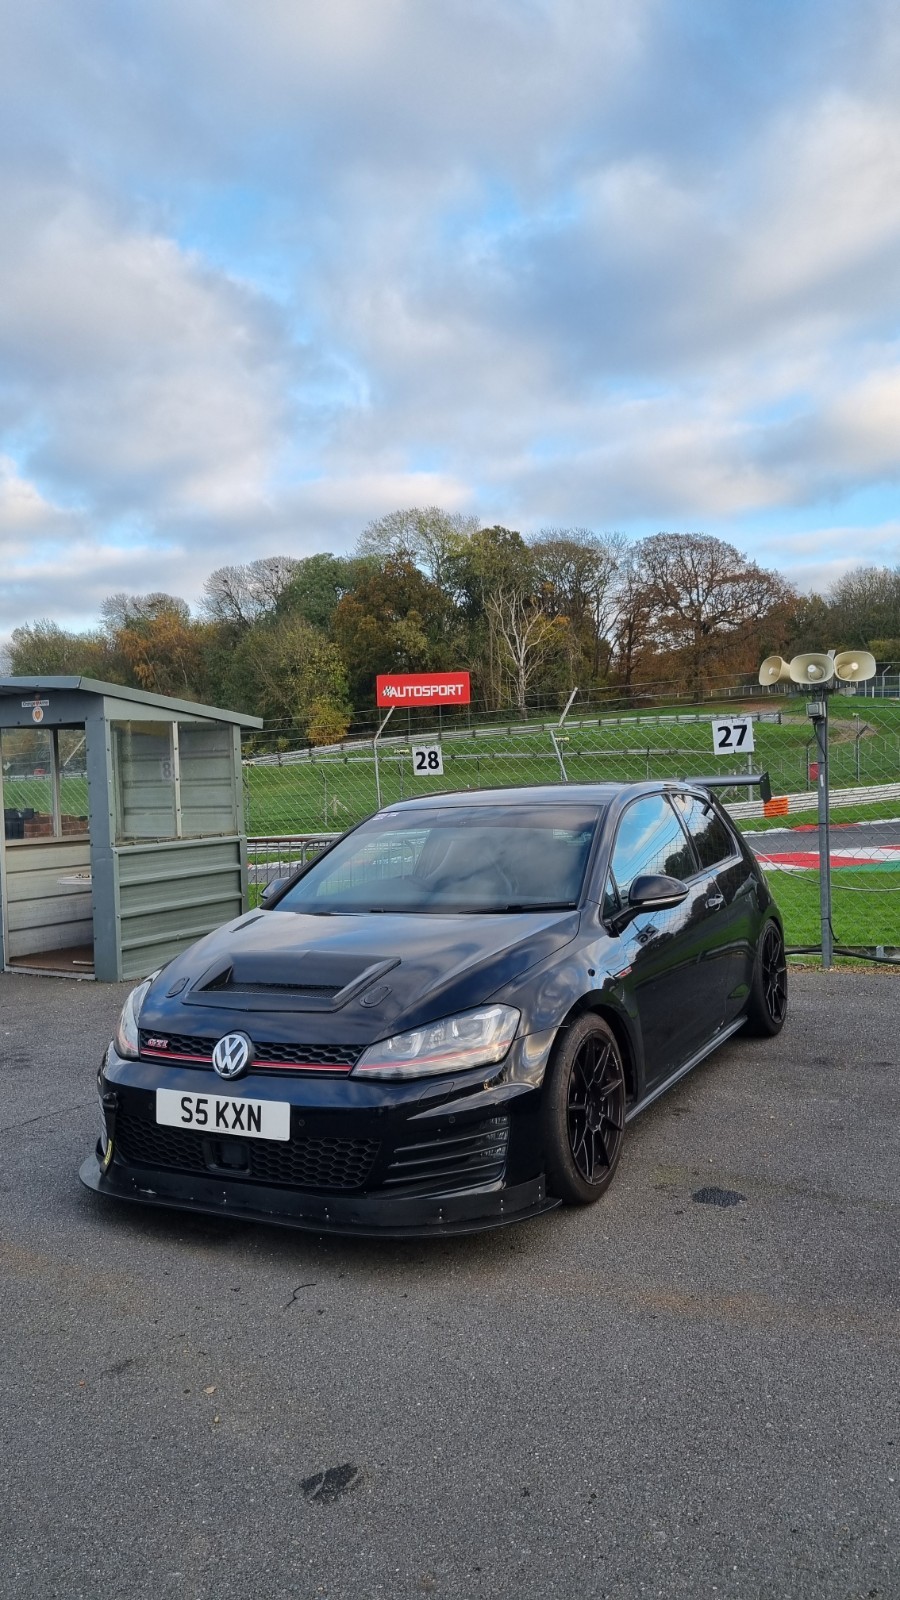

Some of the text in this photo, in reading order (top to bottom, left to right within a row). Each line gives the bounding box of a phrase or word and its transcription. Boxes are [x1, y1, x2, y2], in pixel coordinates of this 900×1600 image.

[389, 684, 464, 697] AUTOSPORT
[717, 724, 748, 748] 27
[415, 750, 440, 770] 28
[147, 1038, 169, 1049] GTI
[180, 1096, 262, 1133] S5 KXN
